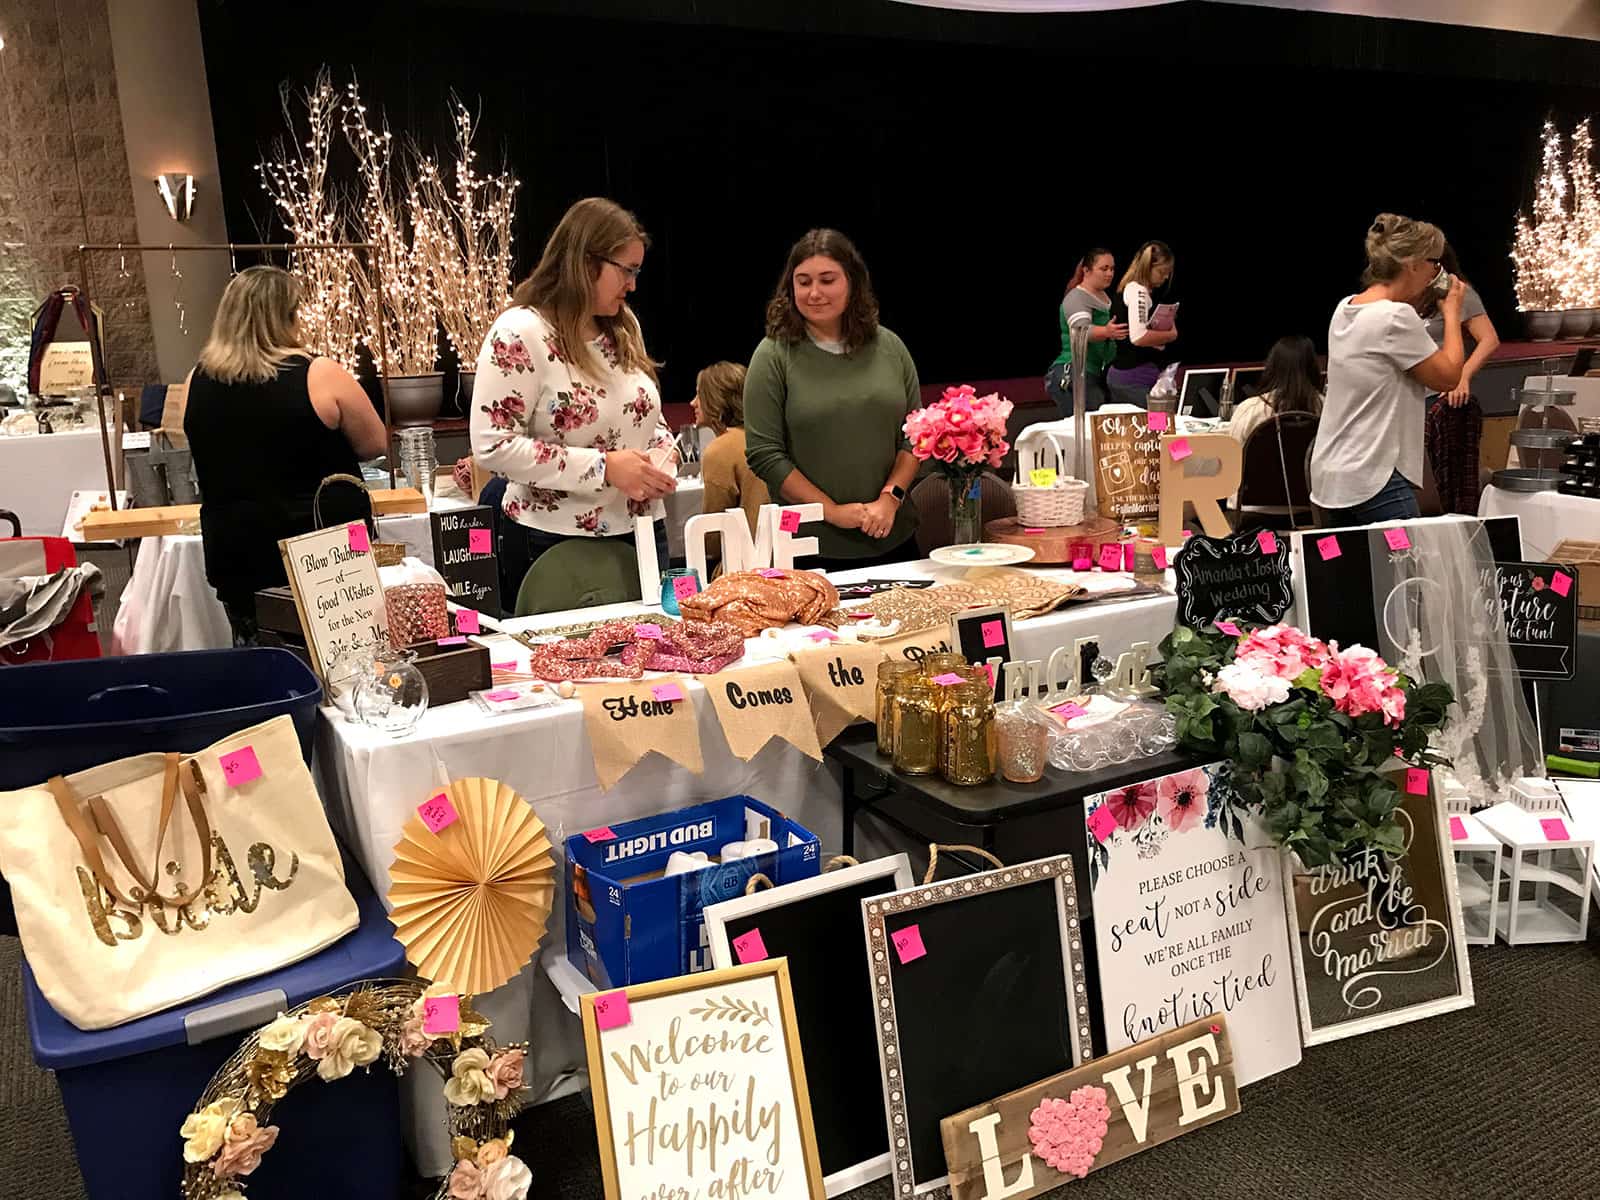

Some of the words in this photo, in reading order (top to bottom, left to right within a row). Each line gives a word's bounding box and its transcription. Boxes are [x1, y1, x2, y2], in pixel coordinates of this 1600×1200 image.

[1097, 416, 1127, 437] Oh
[1134, 440, 1160, 457] captu
[440, 515, 459, 532] HUG
[300, 553, 329, 573] Blow
[443, 547, 472, 565] LAUGH
[335, 569, 345, 584] of
[1192, 562, 1244, 585] Amanda
[1252, 557, 1280, 577] Josh
[1510, 573, 1523, 587] us
[316, 592, 340, 619] Good
[340, 583, 375, 602] Wishes
[451, 581, 471, 597] MILE
[1210, 582, 1271, 607] Wedding
[328, 618, 341, 632] for
[341, 612, 355, 626] the
[356, 608, 374, 622] New
[351, 633, 363, 650] &
[602, 695, 674, 721] Here
[726, 682, 793, 709] Comes
[828, 657, 865, 688] the
[903, 641, 953, 675] Brid
[225, 760, 239, 774] $5
[670, 820, 713, 845] BUD
[605, 832, 667, 862] LIGHT
[803, 844, 815, 855] 24
[1138, 870, 1183, 895] PLEASE
[1186, 853, 1236, 881] CHOOSE
[1238, 851, 1247, 864] A
[1308, 847, 1389, 895] drink
[608, 886, 620, 898] 24
[1330, 875, 1377, 934] and
[1380, 865, 1414, 918] be
[1111, 896, 1170, 952] seat
[1175, 903, 1200, 919] NOT
[1203, 897, 1212, 911] A
[1216, 865, 1270, 917] side
[1144, 942, 1184, 967] WE'RE
[1187, 935, 1209, 953] ALL
[1211, 919, 1253, 944] FAMILY
[1171, 954, 1205, 977] ONCE
[1207, 946, 1232, 964] THE
[426, 1004, 438, 1017] $5
[597, 1000, 609, 1014] $5
[1123, 986, 1188, 1043] knot
[1192, 991, 1217, 1017] is
[1213, 953, 1277, 1012] tied
[611, 1016, 774, 1085] Welcome
[658, 1070, 684, 1101] to
[690, 1070, 736, 1092] our
[624, 1075, 781, 1178] Happily
[969, 1033, 1226, 1200] LVE
[708, 1157, 784, 1200] after
